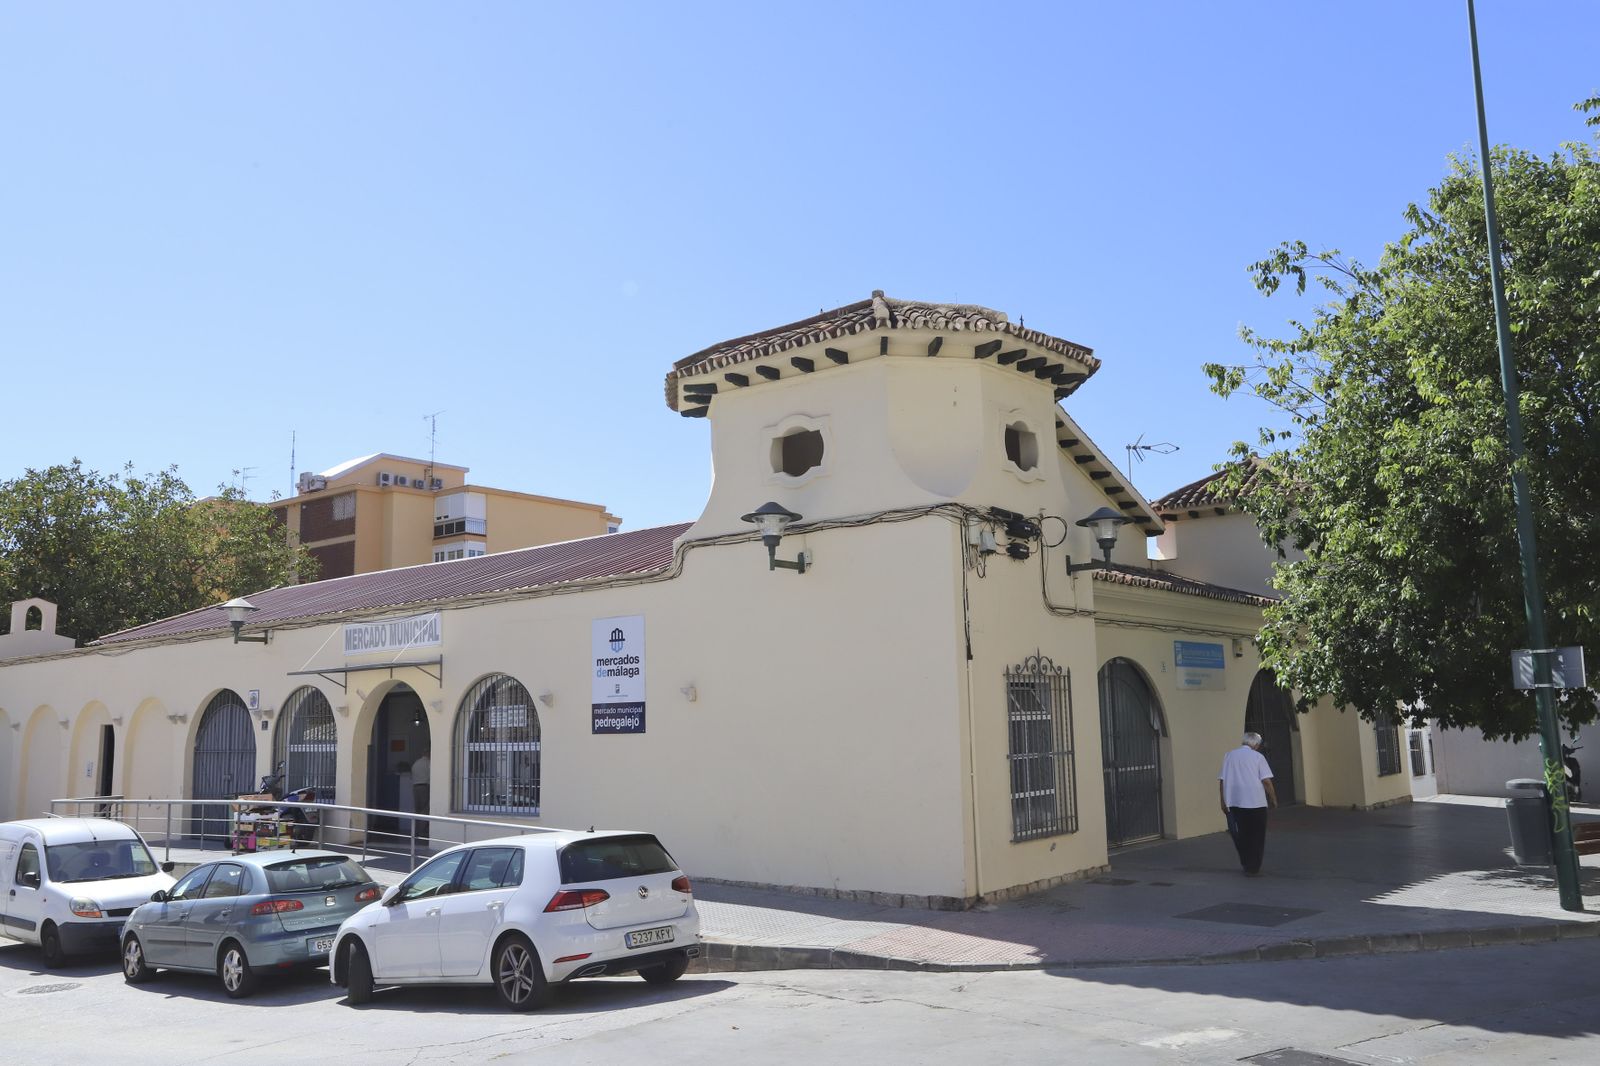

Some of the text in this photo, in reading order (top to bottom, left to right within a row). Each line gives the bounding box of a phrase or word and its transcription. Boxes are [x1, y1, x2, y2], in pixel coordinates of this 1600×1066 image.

[345, 618, 440, 651] MERCADO MUNICIPAL
[597, 654, 640, 667] mercados
[596, 665, 640, 679] demálaga
[617, 705, 643, 714] municipal
[595, 715, 640, 730] pedregalejo
[632, 928, 671, 944] 5237 KFY
